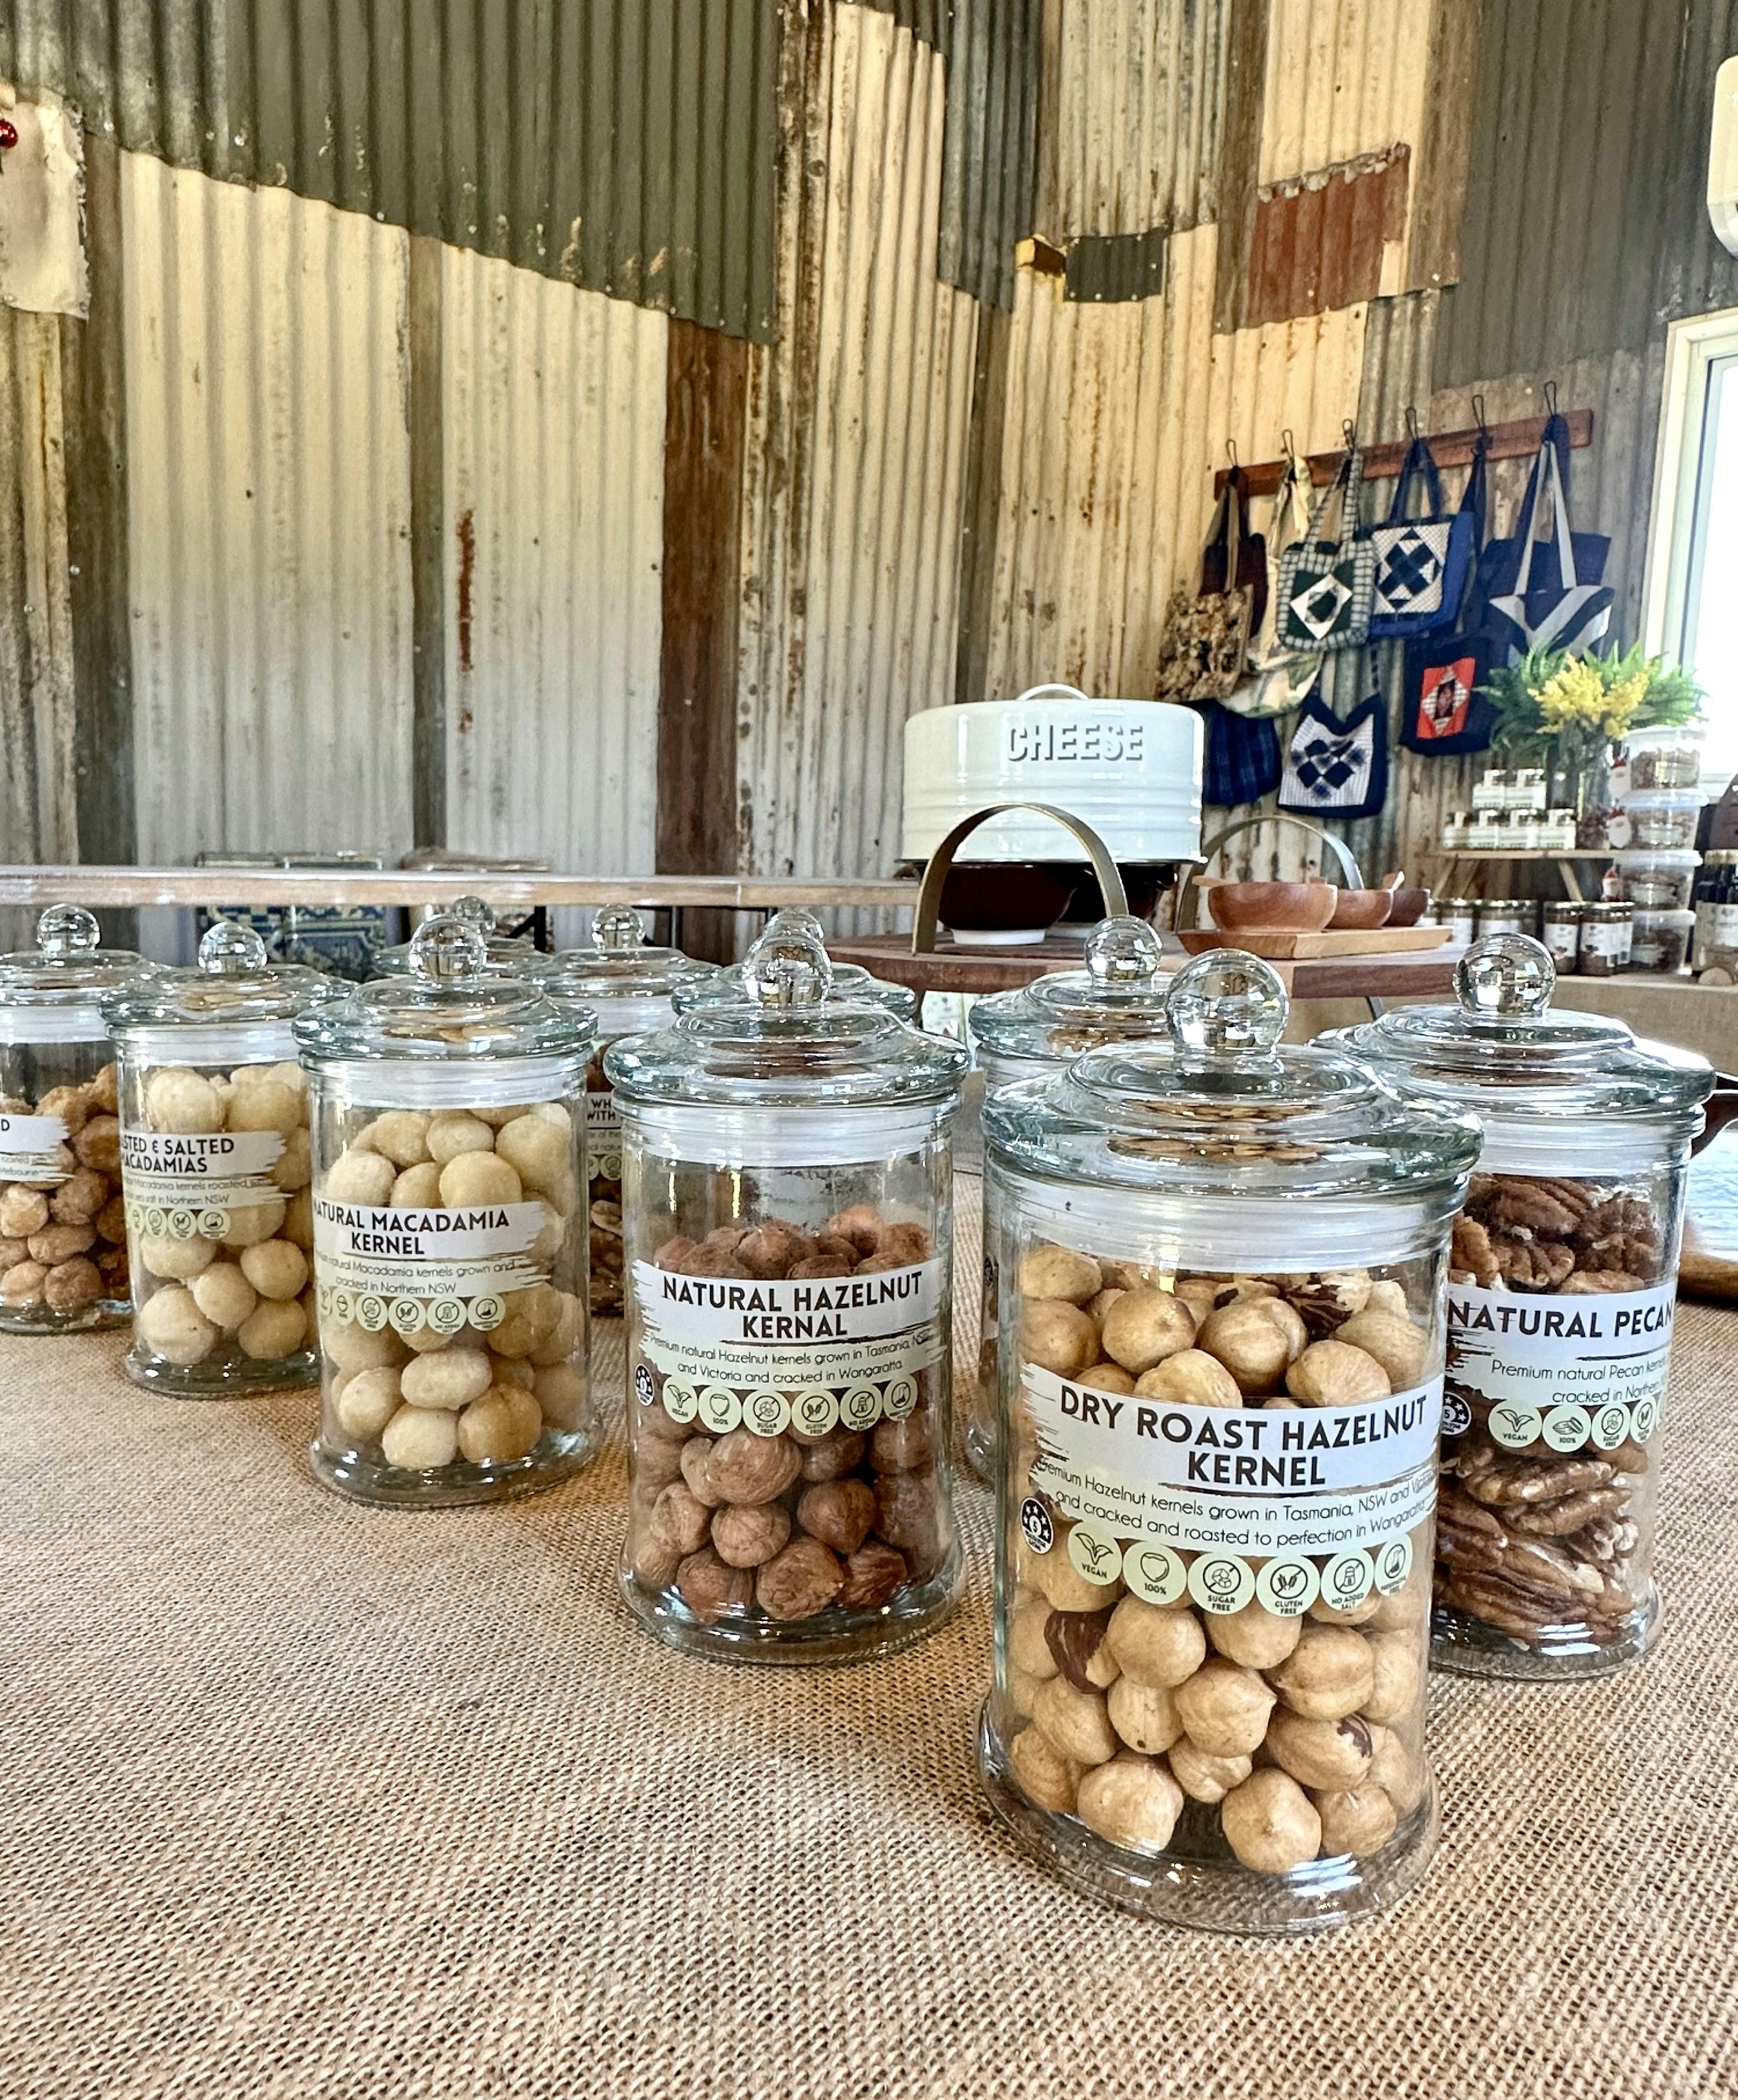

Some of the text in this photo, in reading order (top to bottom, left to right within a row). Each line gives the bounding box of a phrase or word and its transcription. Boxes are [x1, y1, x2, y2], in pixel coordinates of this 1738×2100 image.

[1008, 725, 1144, 761] CHEESE
[164, 1138, 234, 1155] SALTED
[205, 1194, 229, 1205] NSW
[372, 1208, 509, 1233] MACADAMIA
[351, 1231, 425, 1255] KERNEL
[353, 1260, 413, 1277] Macadamia
[416, 1266, 453, 1278] kernels
[456, 1265, 490, 1278] grown
[493, 1259, 515, 1273] and
[370, 1280, 379, 1292] in
[380, 1281, 426, 1295] Northern
[428, 1281, 457, 1295] NSW
[663, 1271, 922, 1312] NATURAL HAZELNUT
[743, 1314, 848, 1339] KERNAL
[1447, 1297, 1674, 1338] NATURAL PECAN
[681, 1345, 716, 1360] natural
[718, 1349, 768, 1365] Hazelnut
[772, 1353, 811, 1365] kernels
[814, 1351, 850, 1366] grown
[853, 1349, 862, 1361] in
[677, 1359, 903, 1384] and Victoria and cracked in Wangaratta
[1491, 1359, 1553, 1380] Premium
[1557, 1365, 1606, 1381] natural
[1609, 1364, 1644, 1380] Pecan
[1552, 1387, 1610, 1403] cracked
[1613, 1389, 1622, 1402] in
[1061, 1384, 1427, 1451] DRY ROAST HAZELNUT
[1503, 1432, 1528, 1441] VEGAN
[1188, 1450, 1326, 1487] KERNEL
[1084, 1474, 1146, 1505] Hazelnut
[1151, 1494, 1203, 1516] kernels
[1208, 1506, 1259, 1520] grown
[1265, 1507, 1278, 1521] in
[1282, 1504, 1354, 1521] Tasmania,
[1358, 1491, 1388, 1513] NSW
[1389, 1487, 1409, 1504] and
[1055, 1490, 1081, 1509] and
[1084, 1502, 1142, 1529] cracked
[1147, 1518, 1180, 1536] and
[1184, 1528, 1249, 1545] roasted
[1255, 1531, 1272, 1545] to
[1277, 1529, 1352, 1549] perfection
[1356, 1524, 1366, 1537] in
[1081, 1563, 1108, 1579] VEGAN
[1144, 1582, 1167, 1595] 100%
[1207, 1595, 1235, 1604] SUGAR
[1212, 1603, 1231, 1611] FREE
[1274, 1600, 1303, 1608] GLUTEN
